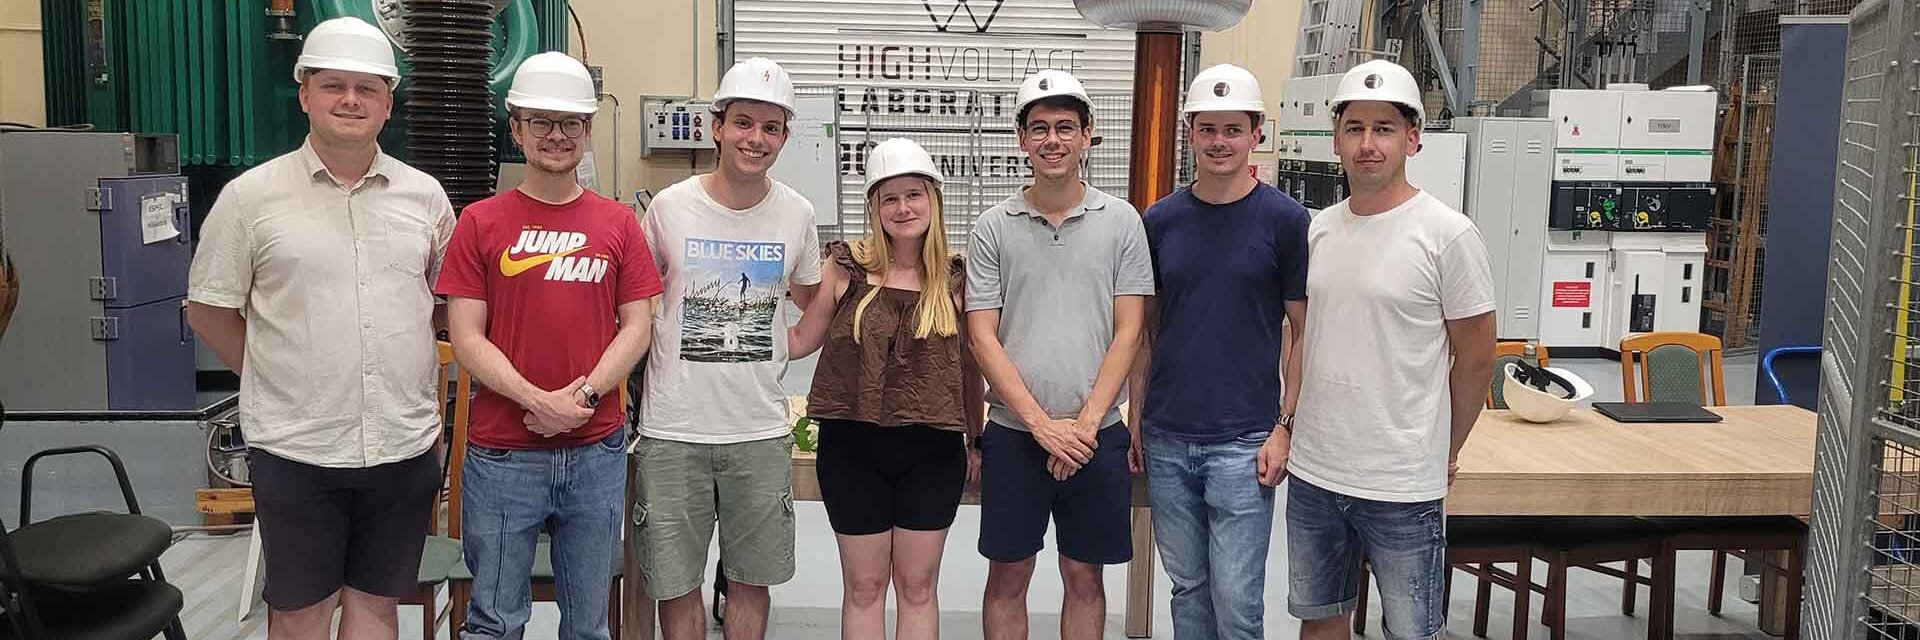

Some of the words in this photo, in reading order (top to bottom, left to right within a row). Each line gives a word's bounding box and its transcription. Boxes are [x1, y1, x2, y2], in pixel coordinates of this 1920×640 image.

[509, 230, 587, 255] JUMP
[686, 240, 734, 261] BLUE
[735, 243, 783, 262] SKIES
[543, 255, 609, 284] MAN
